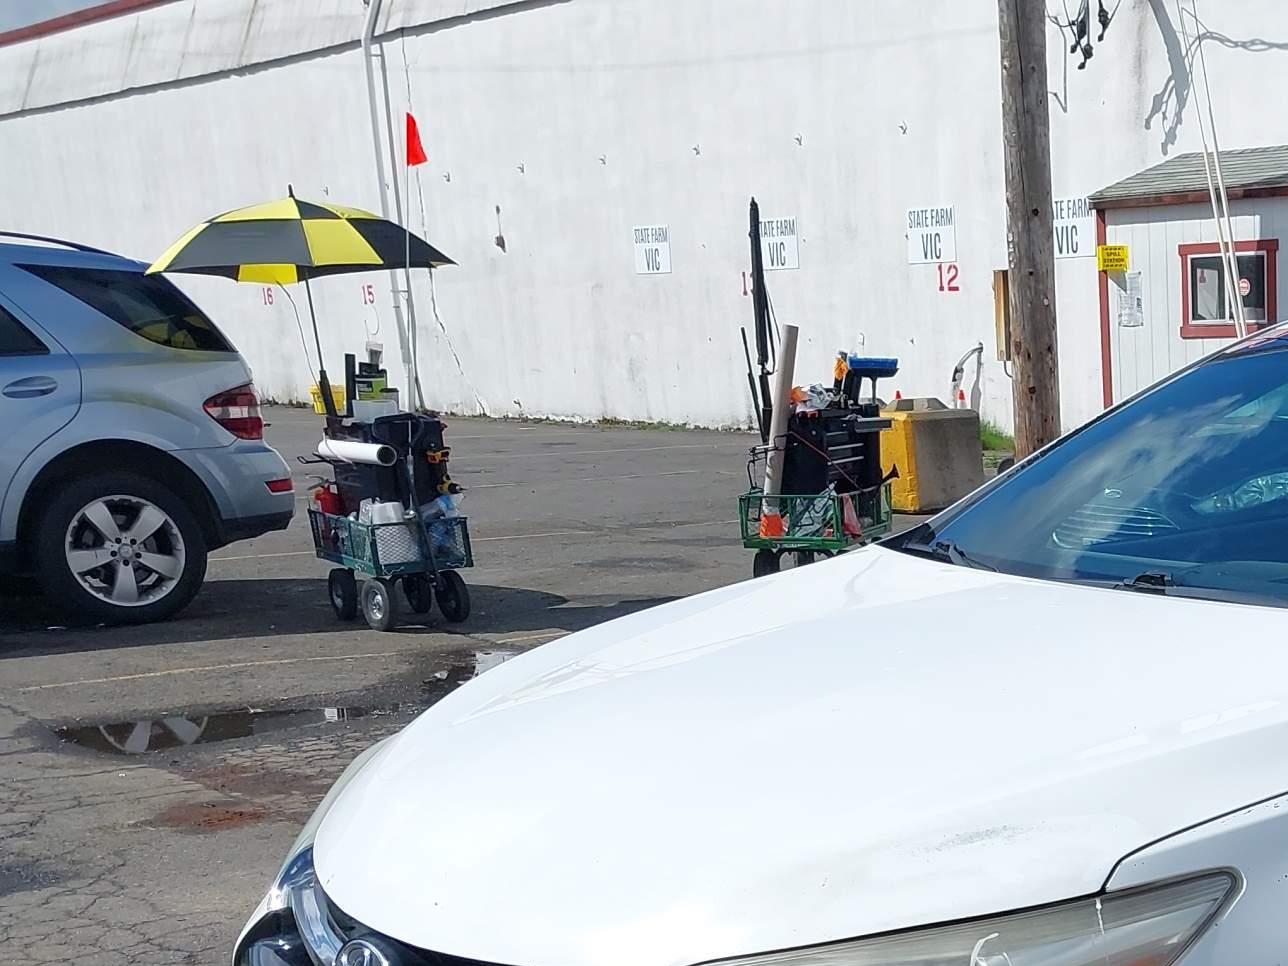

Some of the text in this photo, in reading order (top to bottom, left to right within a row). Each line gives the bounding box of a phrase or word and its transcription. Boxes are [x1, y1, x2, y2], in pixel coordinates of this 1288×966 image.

[759, 219, 796, 238] TATE FARM
[908, 207, 953, 229] STATE FARM
[633, 227, 668, 244] STATE FARM
[921, 232, 942, 260] VIC
[1055, 225, 1078, 254] VIC
[644, 247, 660, 271] VIC
[768, 241, 786, 267] VIC
[937, 263, 960, 291] 12
[362, 285, 375, 305] 15
